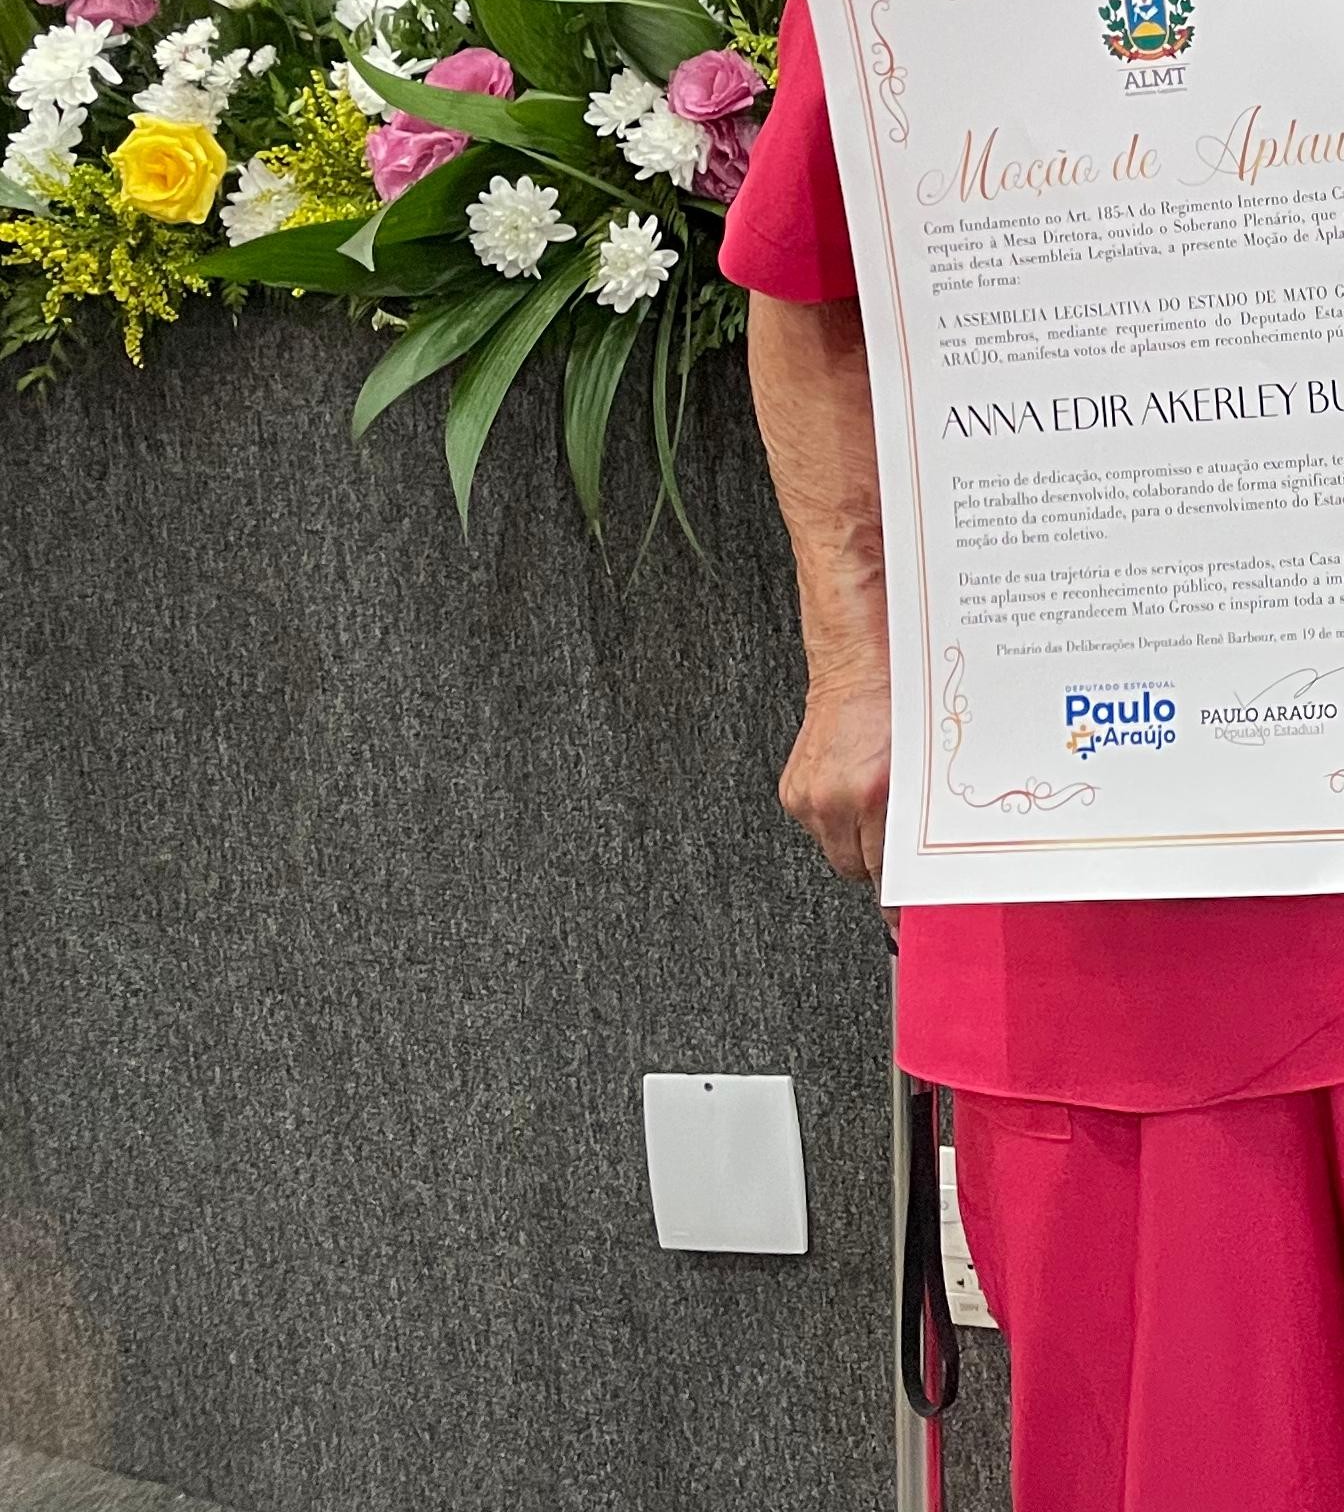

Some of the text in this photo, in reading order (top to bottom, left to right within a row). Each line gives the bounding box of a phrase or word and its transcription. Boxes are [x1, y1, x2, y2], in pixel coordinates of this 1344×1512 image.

[1124, 66, 1186, 90] ALMT
[917, 127, 1099, 206] Moção
[1113, 133, 1161, 182] de
[924, 221, 954, 235] Com
[959, 214, 1040, 232] fundamento
[1096, 204, 1135, 221] 185-A
[1161, 198, 1232, 218] Regimento
[1238, 195, 1288, 209] Interno
[1293, 190, 1327, 204] desta
[927, 237, 983, 257] requeiro
[1004, 234, 1037, 248] Mesa
[1108, 223, 1154, 239] ouvido
[1174, 219, 1237, 234] Soberano
[930, 257, 964, 272] anais
[969, 255, 1003, 269] desta
[1009, 247, 1082, 266] Assembleia
[1182, 237, 1237, 257] presente
[1245, 231, 1288, 249] Moção
[932, 273, 1021, 294] guinte forma:
[954, 307, 1047, 327] ASSEMBLEIA
[1054, 299, 1152, 320] LEGISLATIVA
[1188, 292, 1248, 310] ESTADO
[1284, 286, 1328, 303] MATO
[939, 336, 967, 347] seus
[1047, 324, 1107, 339] mediante
[1116, 316, 1207, 338] requerimento
[1240, 308, 1306, 328] Deputado
[1008, 346, 1070, 362] manifesta
[1073, 344, 1106, 357] votos
[1131, 339, 1186, 357] aplausos
[1215, 328, 1322, 347] reconhecimento
[939, 398, 1044, 438] ANNA
[1052, 393, 1133, 431] EDIR
[1139, 382, 1300, 426] AKERLEY
[951, 476, 974, 490] Por
[979, 474, 1010, 488] meio
[1105, 463, 1192, 484] compromisso
[1207, 459, 1259, 476] atuação
[953, 494, 980, 513] pelo
[984, 491, 1038, 507] trabalho
[1132, 481, 1214, 498] colaborando
[1237, 479, 1277, 492] forma
[954, 513, 1018, 528] lecimento
[1177, 497, 1288, 515] desenvolvimento
[956, 533, 998, 550] moção
[958, 571, 1001, 586] Diante
[1051, 564, 1110, 584] trajetória
[1152, 560, 1204, 577] serviços
[1279, 555, 1305, 568] esta
[1309, 553, 1340, 566] Casa
[959, 593, 986, 605] seus
[990, 589, 1046, 607] aplausos
[1062, 582, 1168, 599] reconhecimento
[1232, 573, 1307, 590] ressaltando
[961, 609, 1007, 624] ciativas
[1040, 604, 1127, 624] engrandecem
[1131, 601, 1165, 615] Mato
[1169, 600, 1214, 614] Grosso
[1230, 595, 1288, 614] inspiram
[1294, 593, 1323, 607] toda
[1065, 681, 1176, 693] DEPUTADO ESTADUAL
[1065, 691, 1176, 726] Paulo
[1201, 701, 1338, 725] PAULO ARAÚJO
[1102, 725, 1176, 749] Araújo
